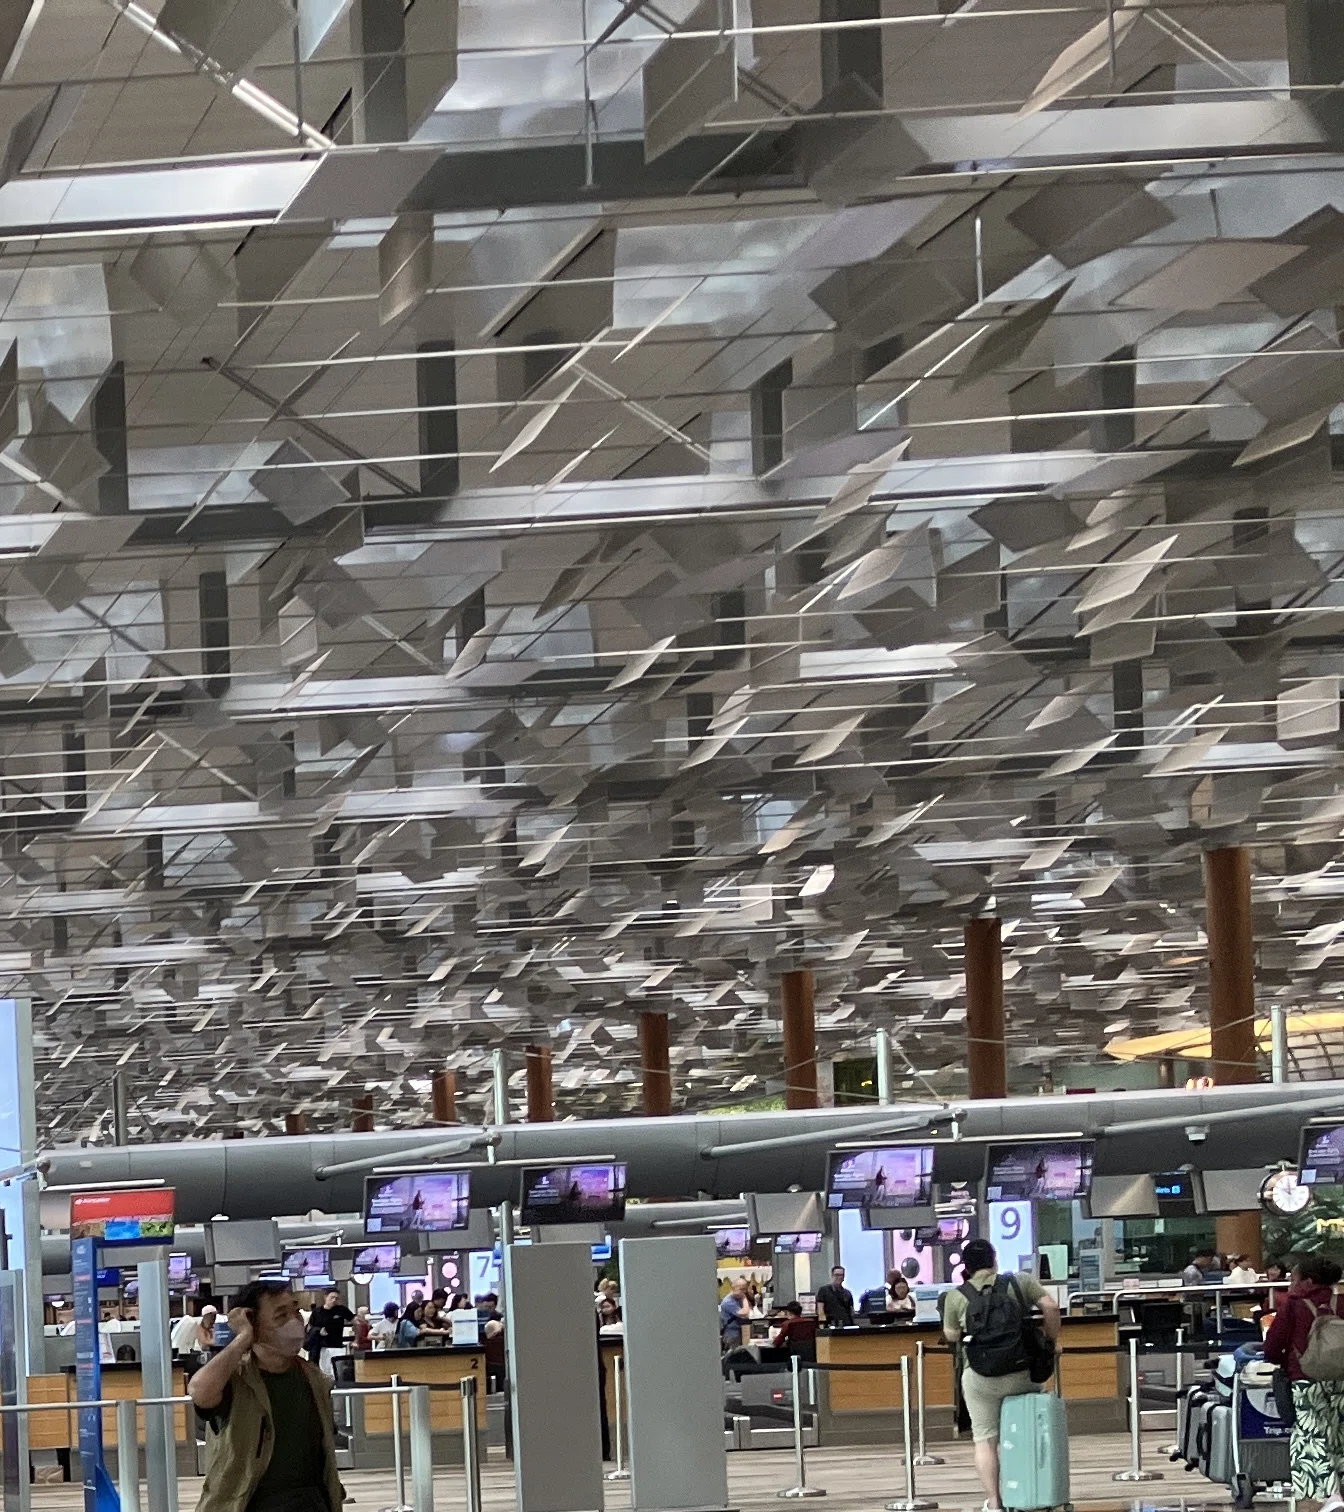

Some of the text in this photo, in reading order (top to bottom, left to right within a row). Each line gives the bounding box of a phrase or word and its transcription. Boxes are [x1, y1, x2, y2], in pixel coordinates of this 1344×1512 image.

[1000, 1206, 1021, 1240] 9
[476, 1256, 490, 1278] 7
[470, 1358, 479, 1370] 2
